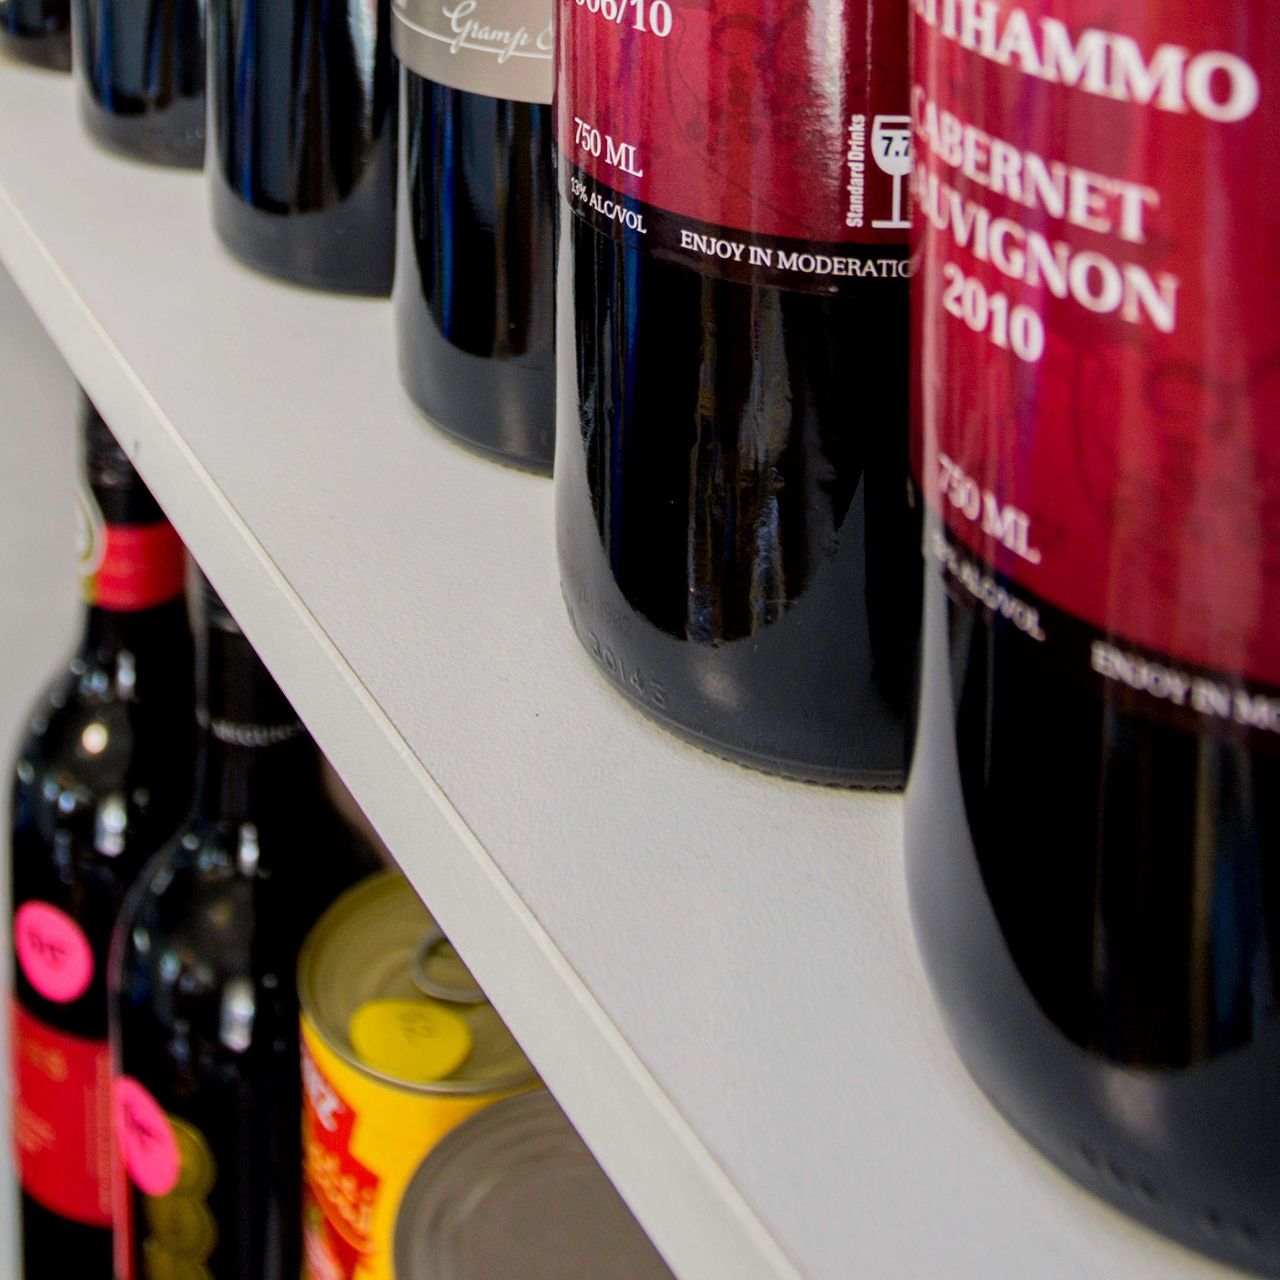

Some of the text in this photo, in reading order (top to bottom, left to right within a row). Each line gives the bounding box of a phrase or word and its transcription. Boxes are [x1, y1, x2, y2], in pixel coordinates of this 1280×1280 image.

[574, 117, 644, 179] 750 ML
[845, 113, 866, 228] Standard Drinks
[589, 192, 648, 235] ALC/VOL
[680, 229, 912, 278] ENJOY IN MODERATIO
[941, 260, 1046, 364] 2010
